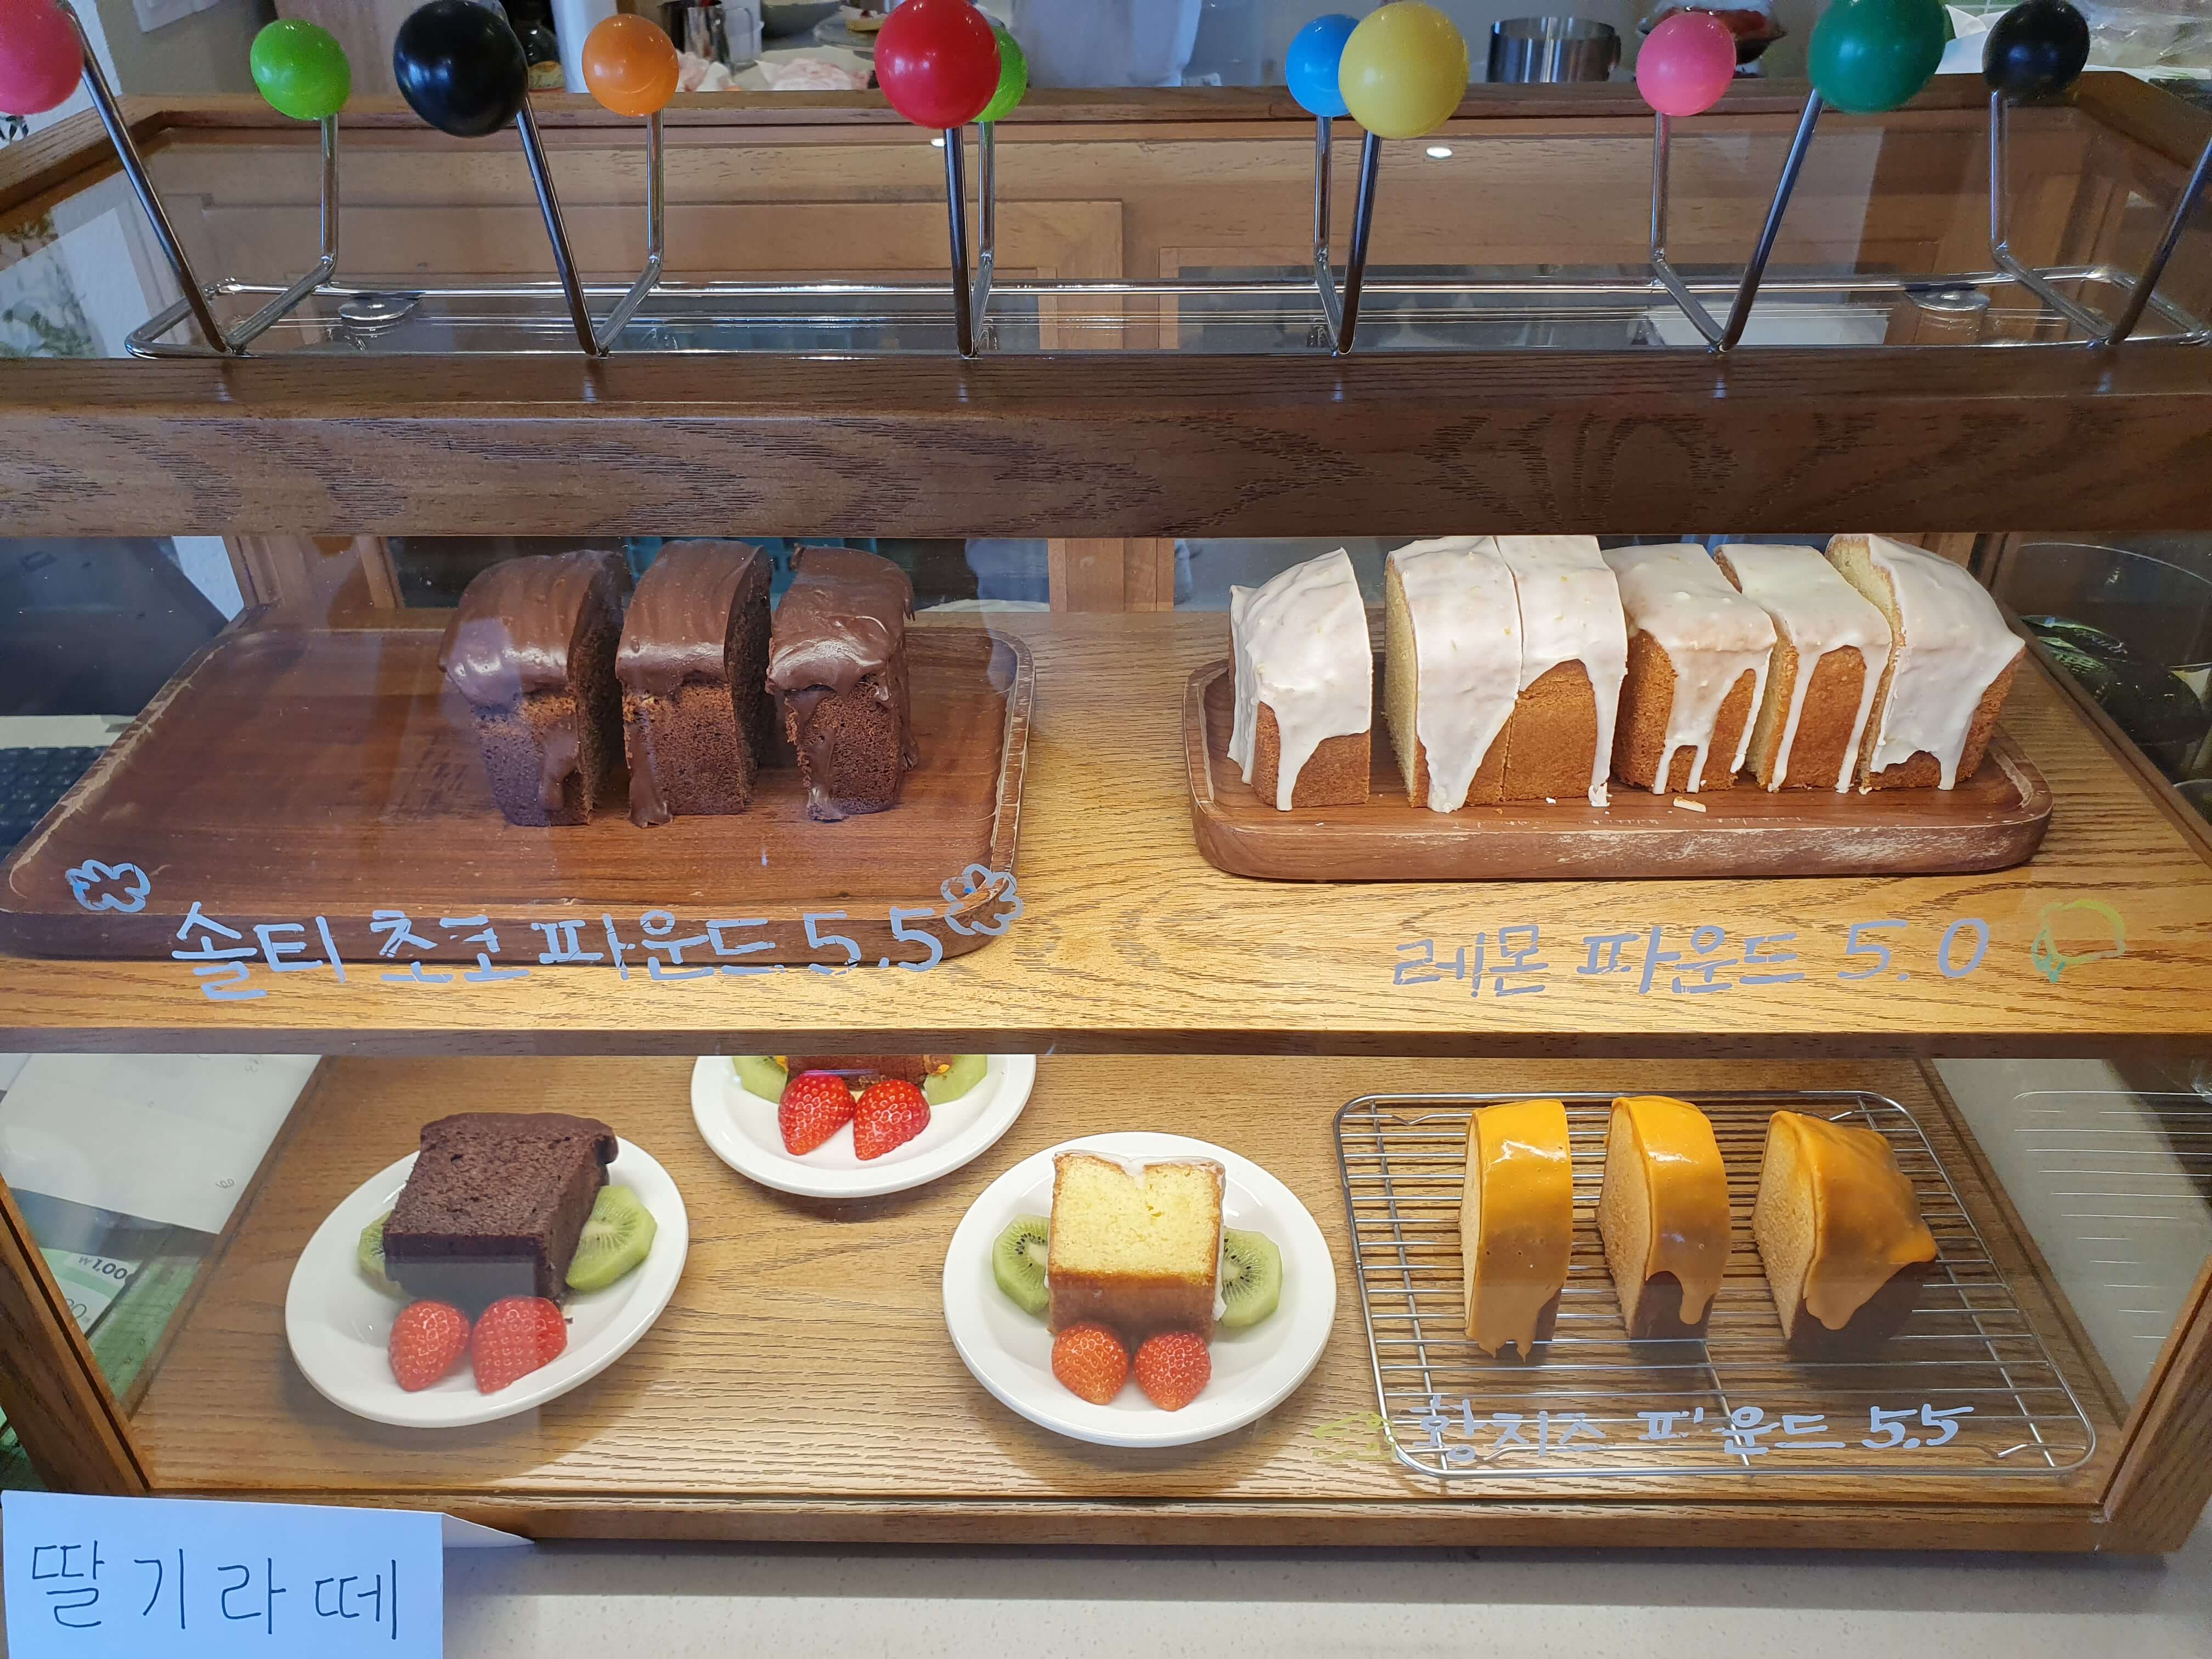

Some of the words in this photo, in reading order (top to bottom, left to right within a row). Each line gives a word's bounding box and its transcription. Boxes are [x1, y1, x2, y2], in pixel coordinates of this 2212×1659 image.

[171, 901, 346, 1000] 솔티
[803, 907, 944, 976] 5.5
[1392, 924, 1549, 997] 레몬
[1577, 925, 1804, 994] 파운드
[1837, 918, 1990, 981] 5.0
[1861, 1403, 1974, 1449] 5.5
[31, 1540, 397, 1640] 딸기라떼
